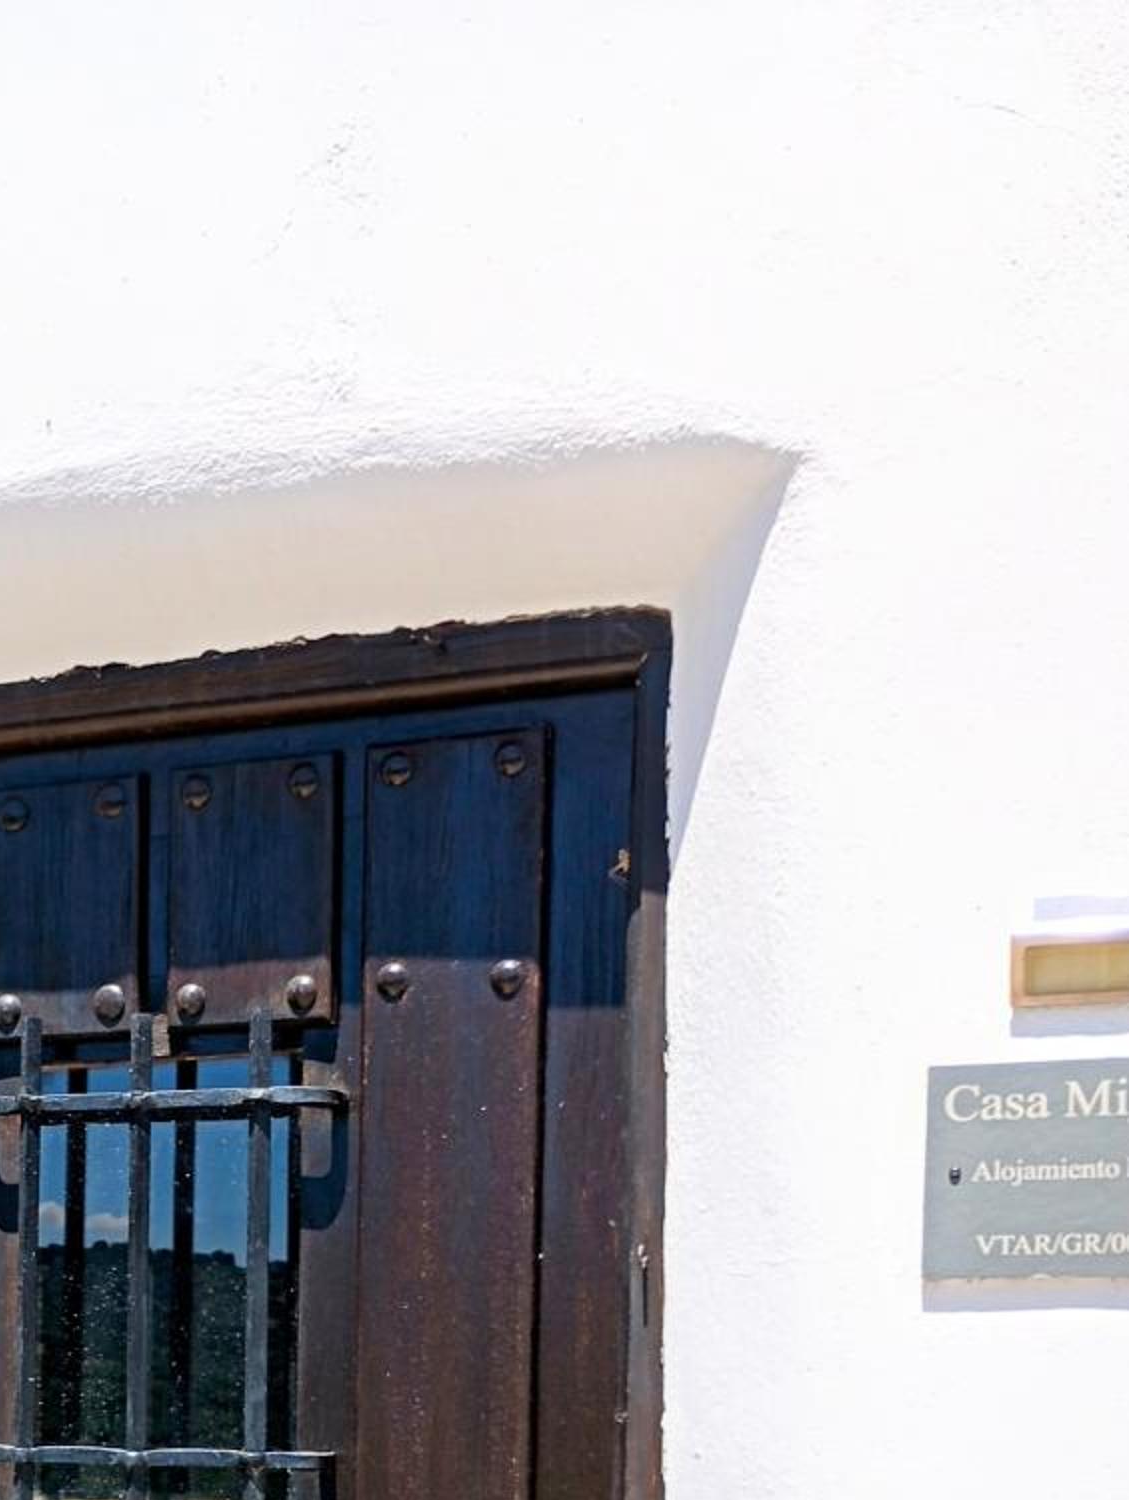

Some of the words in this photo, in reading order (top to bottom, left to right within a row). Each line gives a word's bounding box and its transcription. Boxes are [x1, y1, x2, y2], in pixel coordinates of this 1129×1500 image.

[944, 1084, 1051, 1122] Casa
[1064, 1077, 1129, 1118] Mi
[971, 1157, 1121, 1186] Alojamiento
[976, 1231, 1129, 1256] VTAR/GR/0
